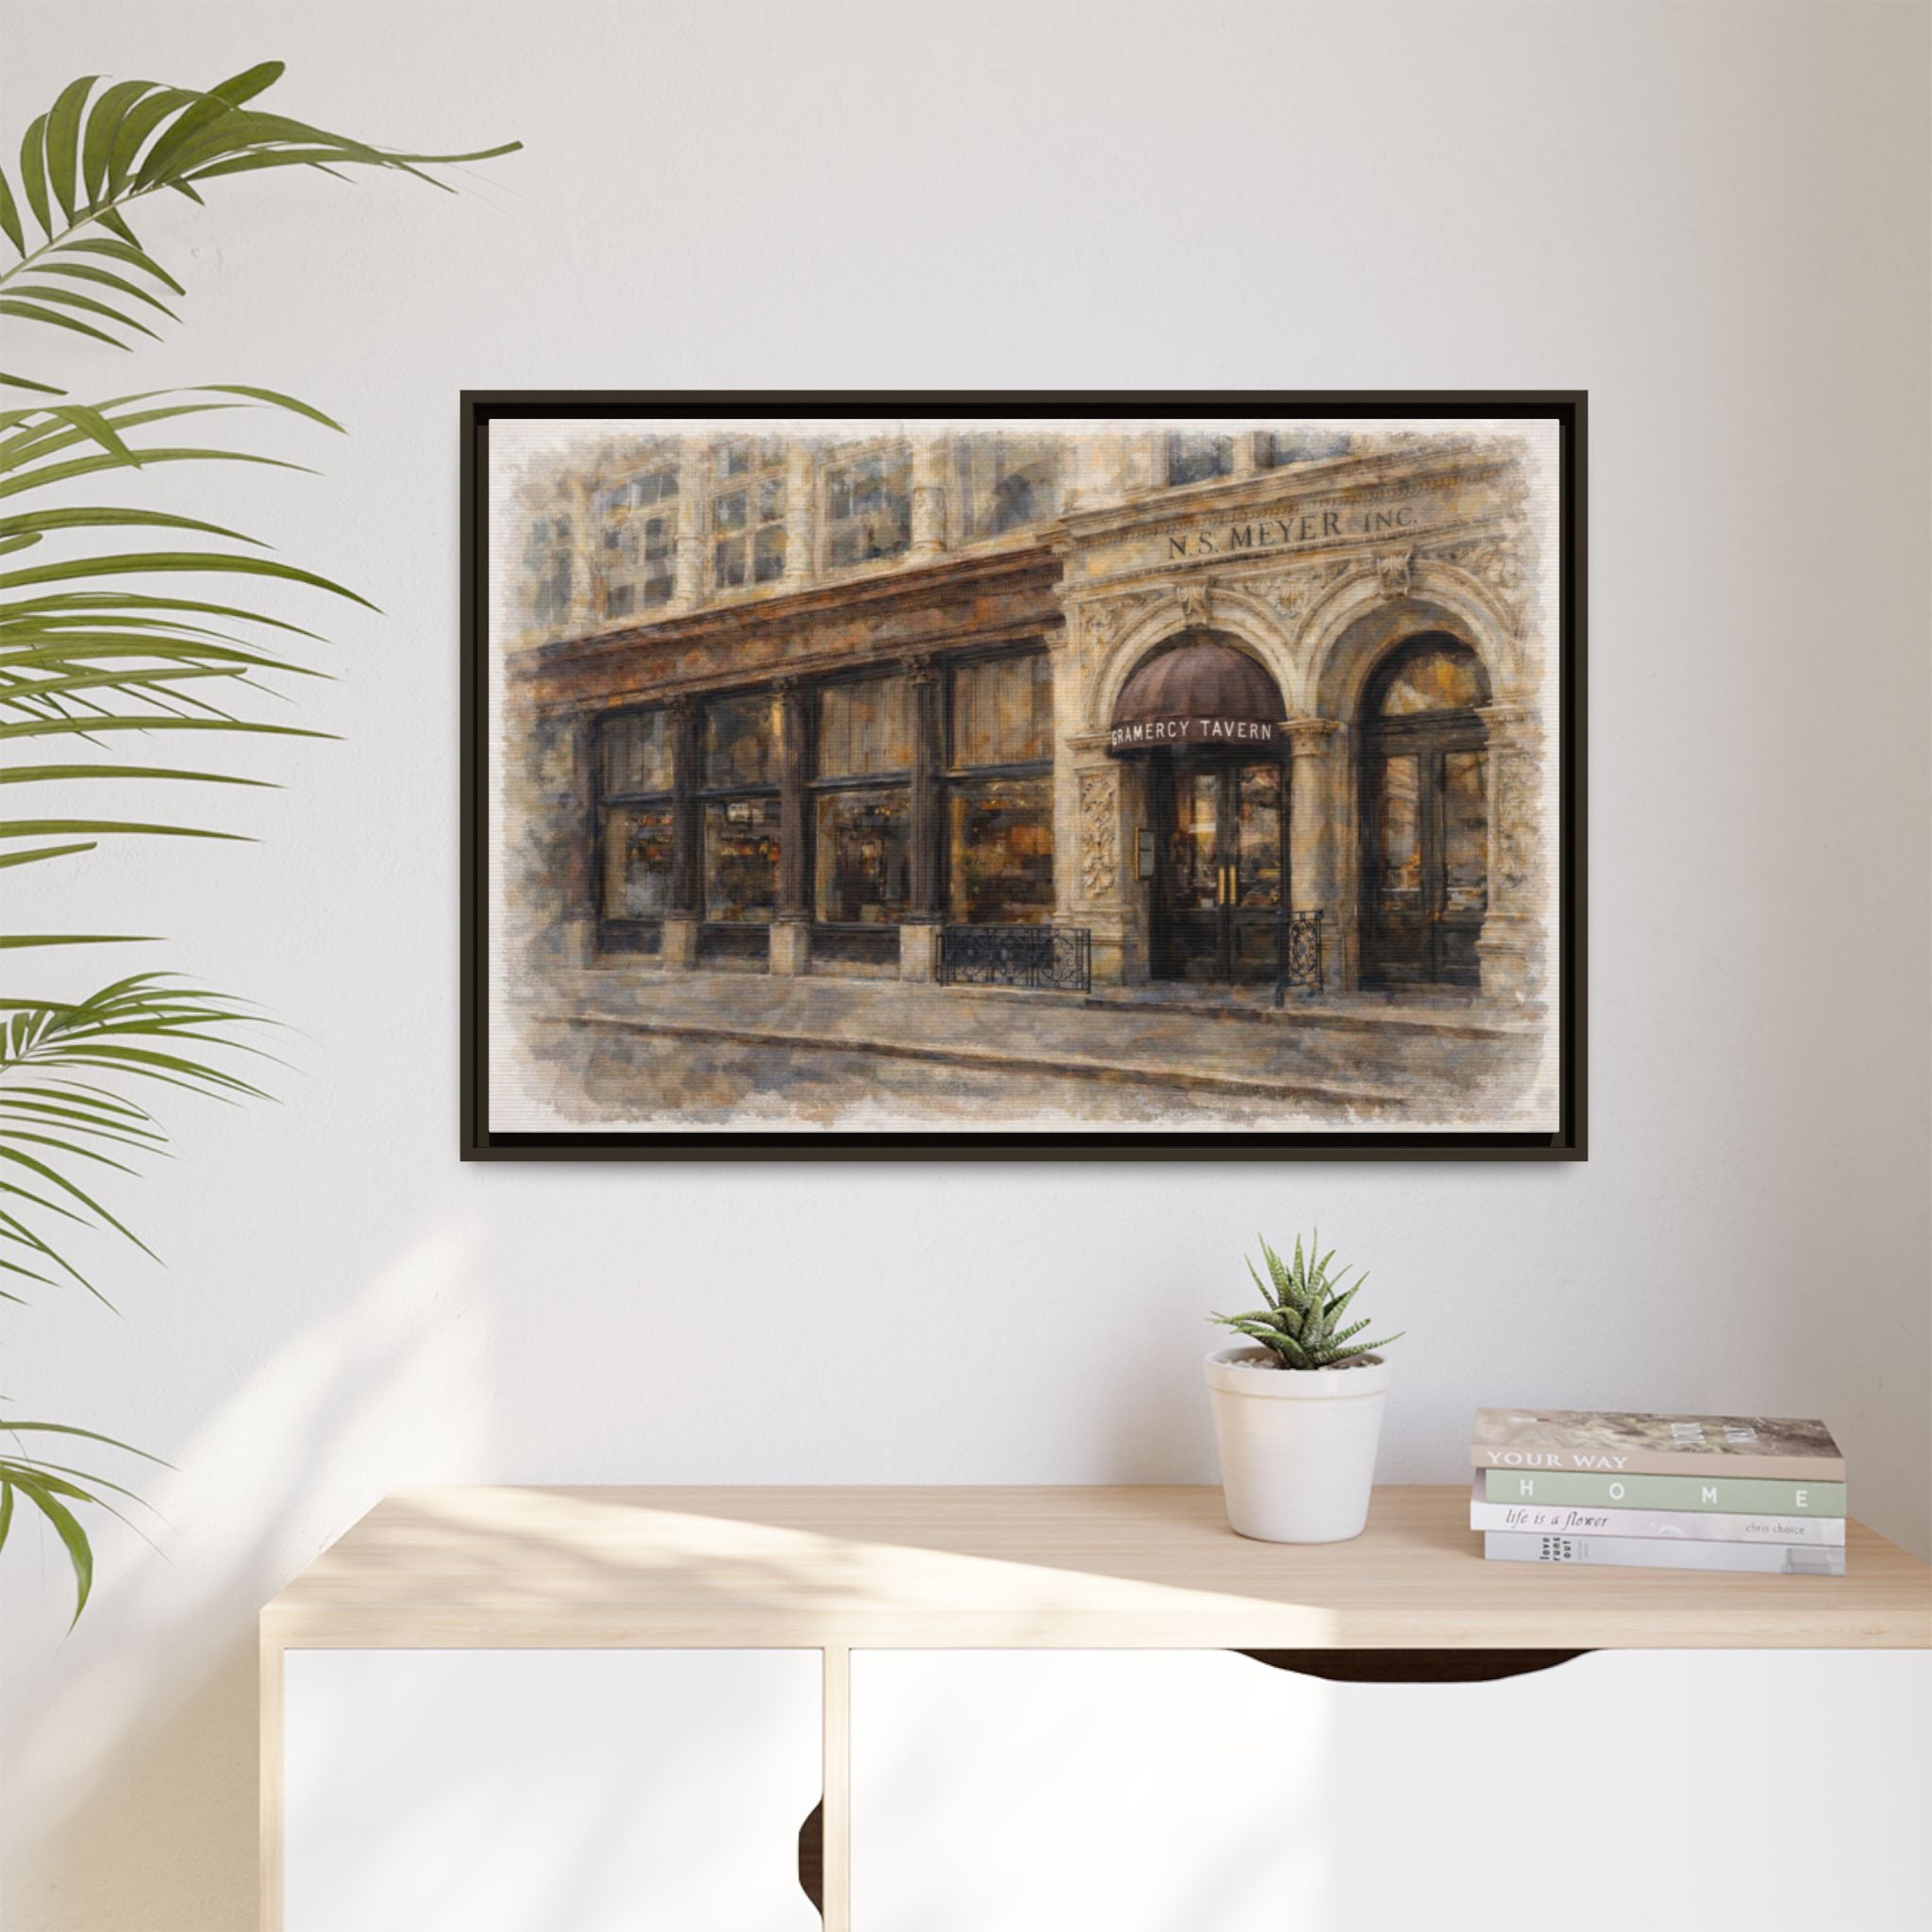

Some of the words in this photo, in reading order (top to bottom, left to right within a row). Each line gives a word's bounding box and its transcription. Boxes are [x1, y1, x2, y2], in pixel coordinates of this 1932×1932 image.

[1230, 511, 1341, 550] MEYER
[1363, 508, 1418, 532] INC.
[1111, 721, 1190, 745] GRAMERCY
[1200, 720, 1271, 740] TAVERN
[1487, 1451, 1562, 1467] YOUR
[1572, 1454, 1628, 1469] WAY
[1506, 1508, 1528, 1528] life
[1534, 1511, 1546, 1524] is
[1551, 1515, 1559, 1524] a
[1562, 1511, 1608, 1531] flower
[1745, 1523, 1769, 1533] chris
[1773, 1523, 1805, 1534] choice
[1540, 1537, 1550, 1560] love
[1553, 1537, 1561, 1561] runs
[1562, 1540, 1572, 1558] out
